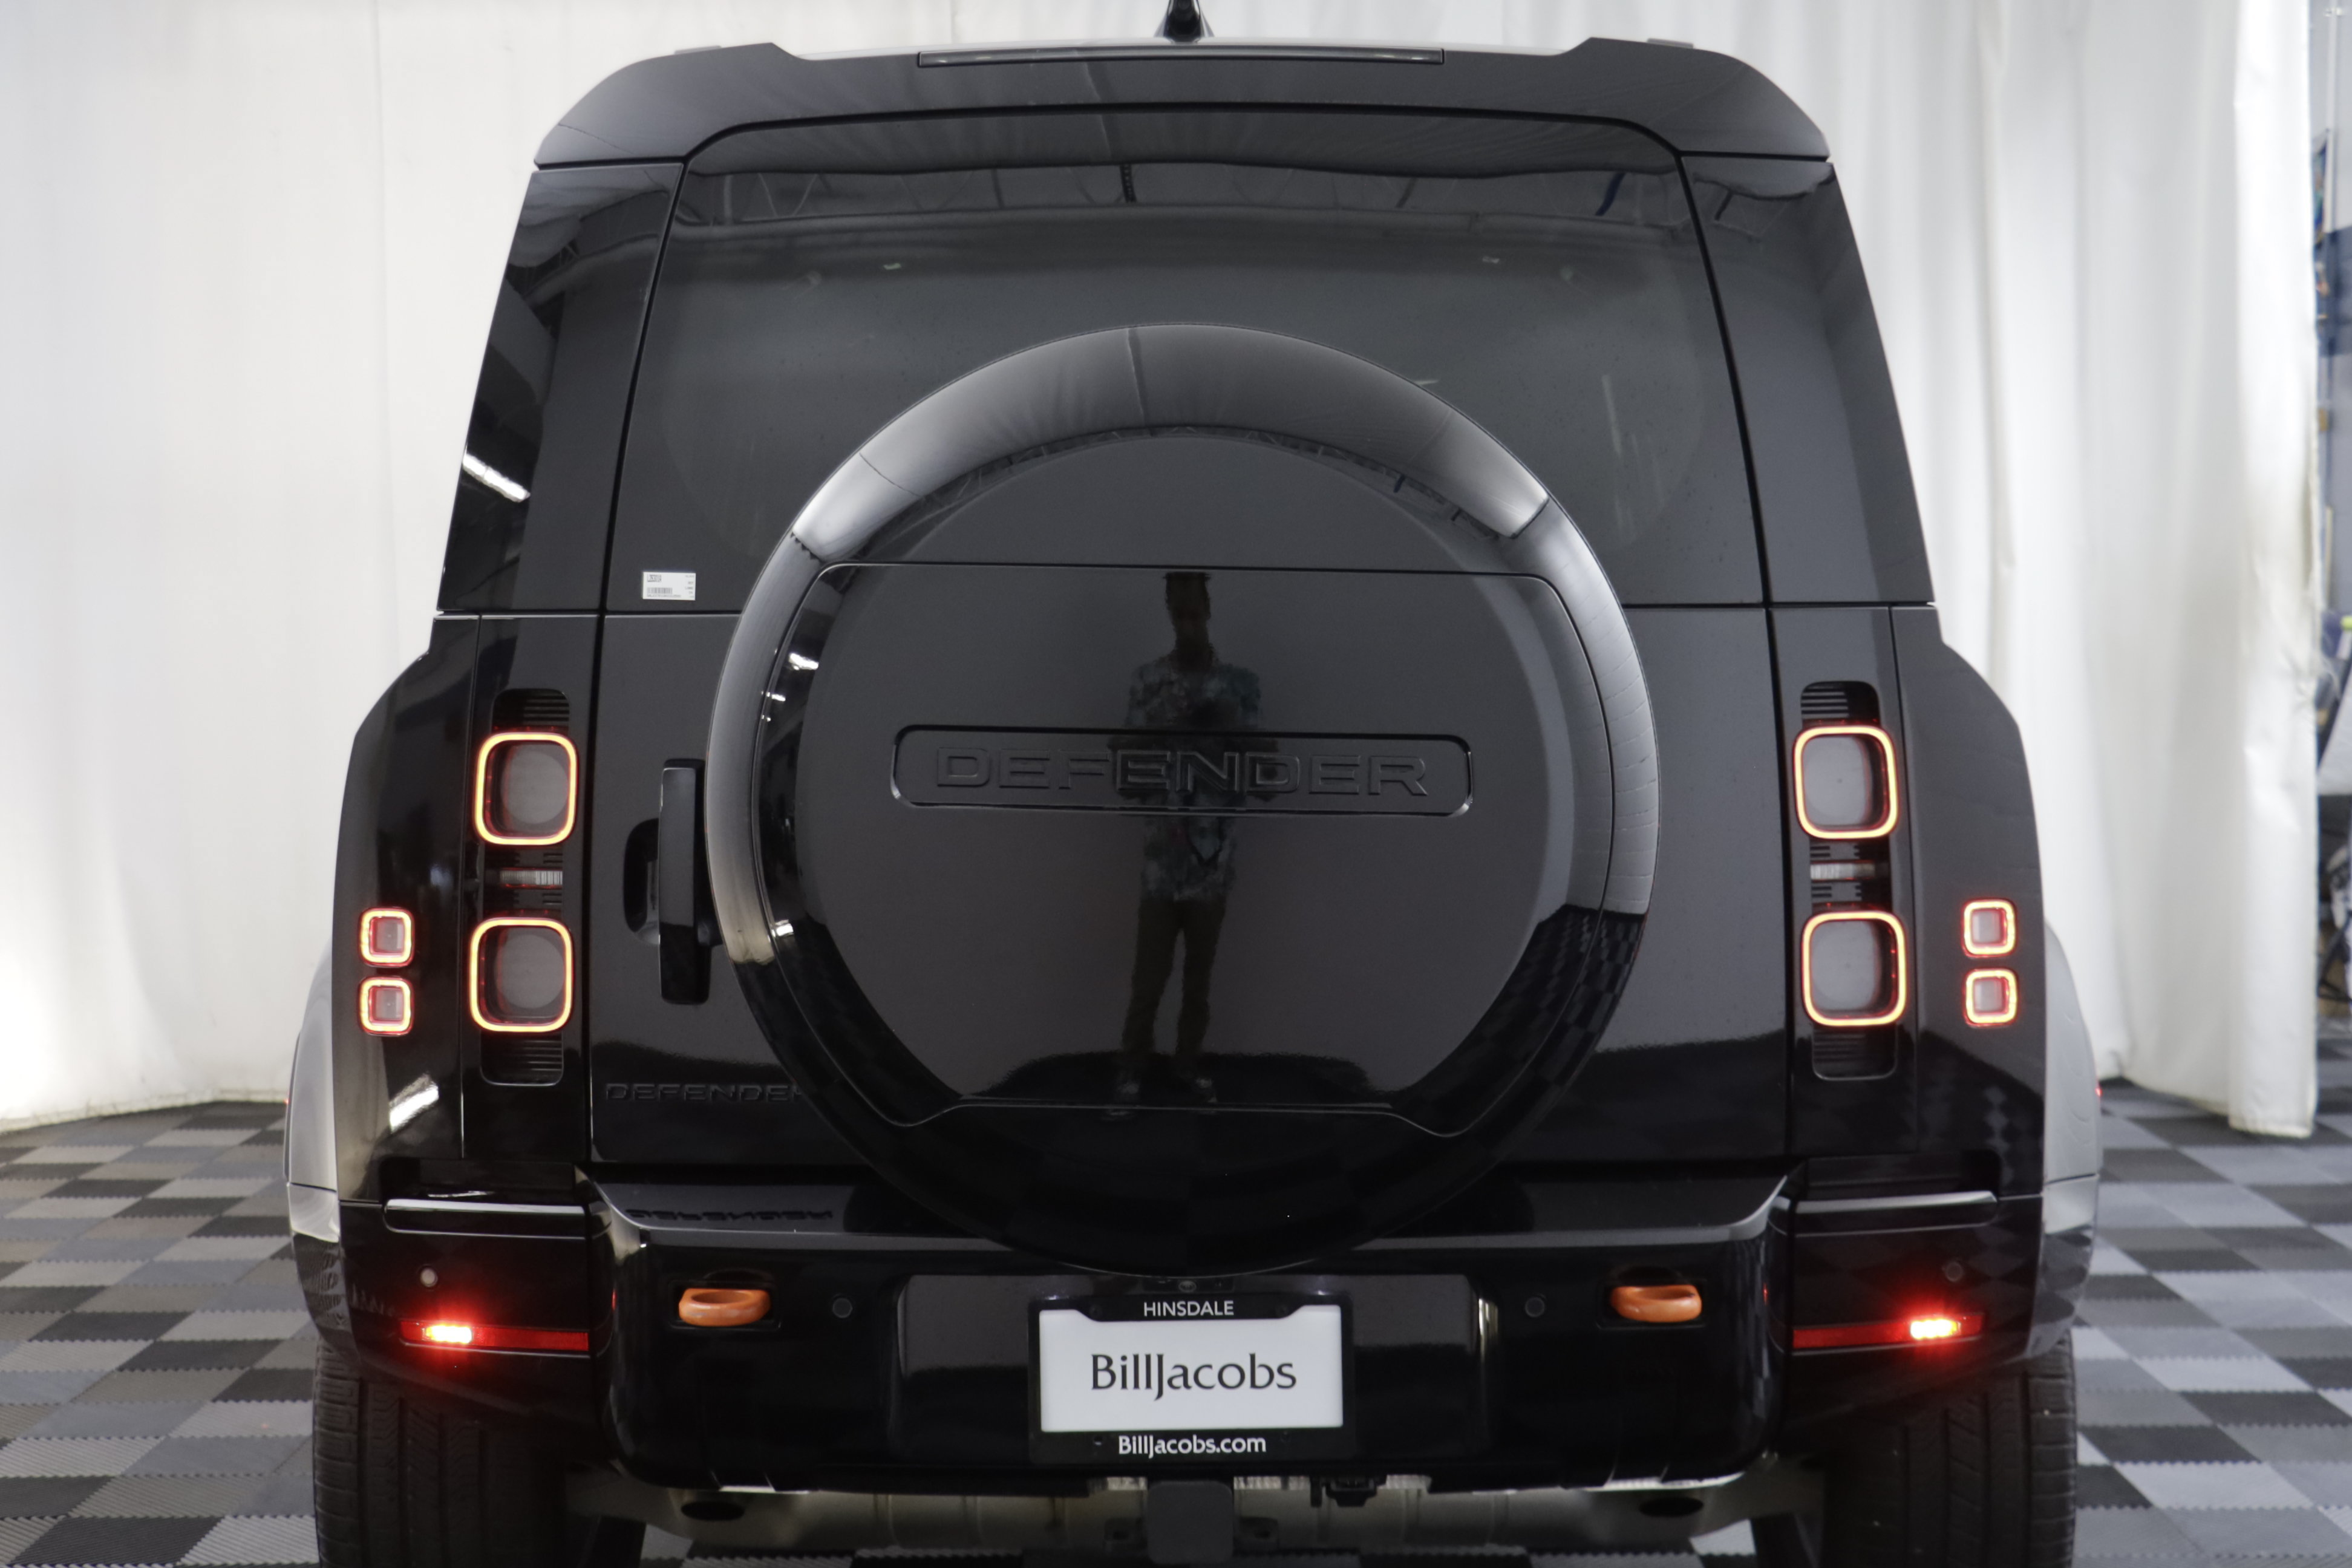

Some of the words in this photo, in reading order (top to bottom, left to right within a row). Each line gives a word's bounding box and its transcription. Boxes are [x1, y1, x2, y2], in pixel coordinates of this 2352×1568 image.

[936, 746, 1429, 797] DEFENDER
[1143, 1300, 1235, 1317] HINSDALE
[1091, 1352, 1297, 1401] BillJacobs
[1118, 1434, 1267, 1459] BillJacobs.com
